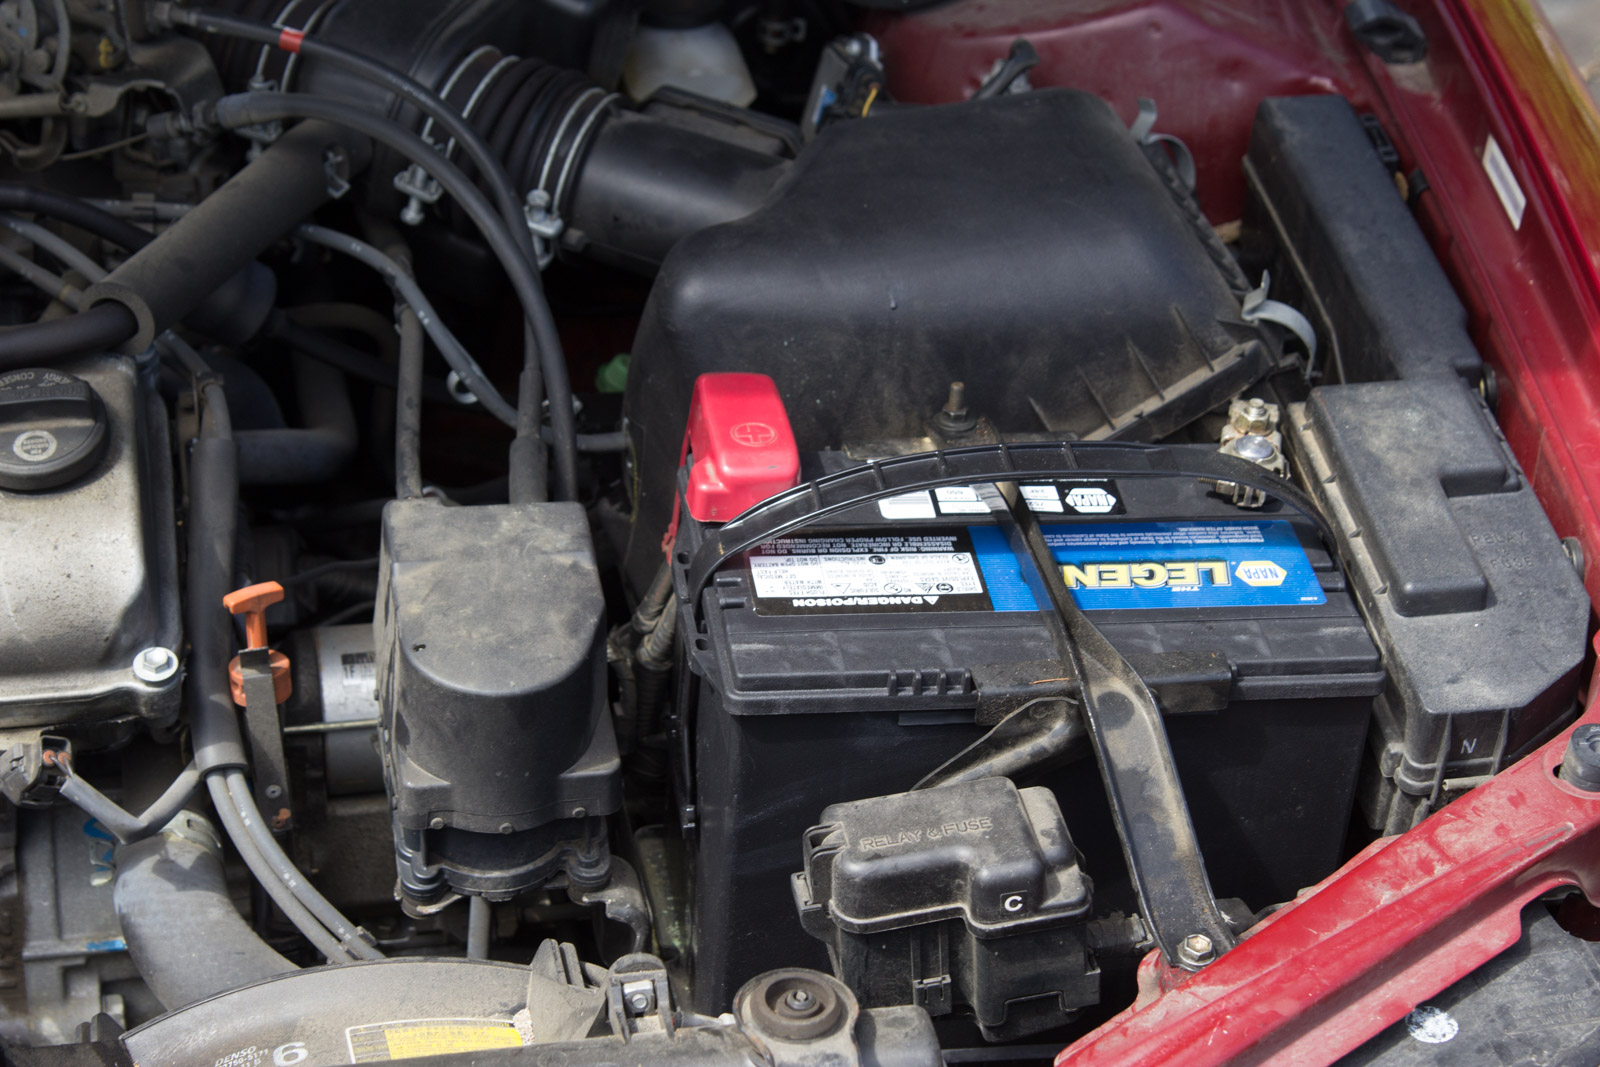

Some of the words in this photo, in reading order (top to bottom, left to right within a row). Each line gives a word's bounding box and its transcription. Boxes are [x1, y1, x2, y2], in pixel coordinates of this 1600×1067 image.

[1072, 494, 1108, 507] NAPA
[1490, 555, 1535, 570] FUSE
[1056, 560, 1231, 589] LEGEN
[1243, 565, 1279, 581] NAPA
[792, 596, 923, 607] DANGER/POISON
[1461, 738, 1478, 755] N
[860, 831, 924, 851] RELAY
[926, 829, 943, 839] &
[943, 817, 994, 837] FUSE
[1004, 895, 1025, 913] C
[214, 1045, 257, 1067] DENSO
[219, 1048, 269, 1067] 750-5171
[273, 1041, 309, 1067] 6
